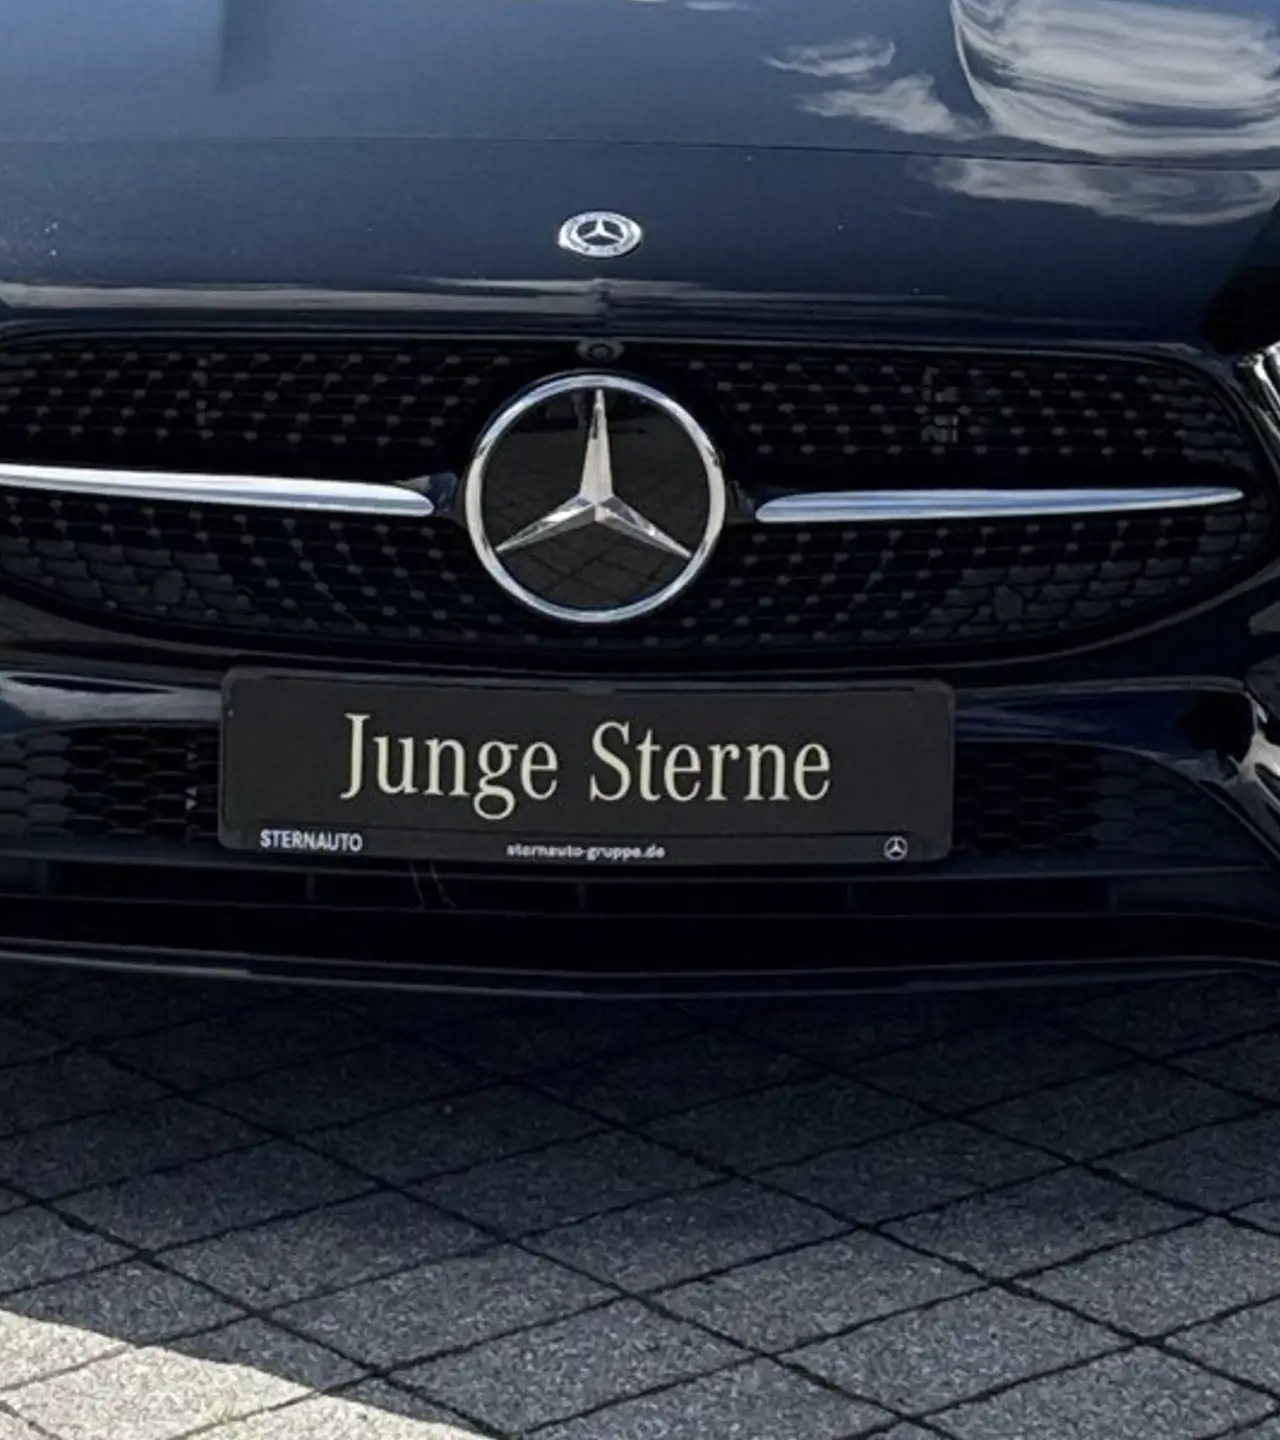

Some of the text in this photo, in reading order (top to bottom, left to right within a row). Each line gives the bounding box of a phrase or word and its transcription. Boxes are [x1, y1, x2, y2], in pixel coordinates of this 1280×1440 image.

[340, 713, 831, 820] Junge Sterne
[260, 829, 363, 852] STERNAUTO
[506, 843, 666, 862] sternauto-gruppe.de
